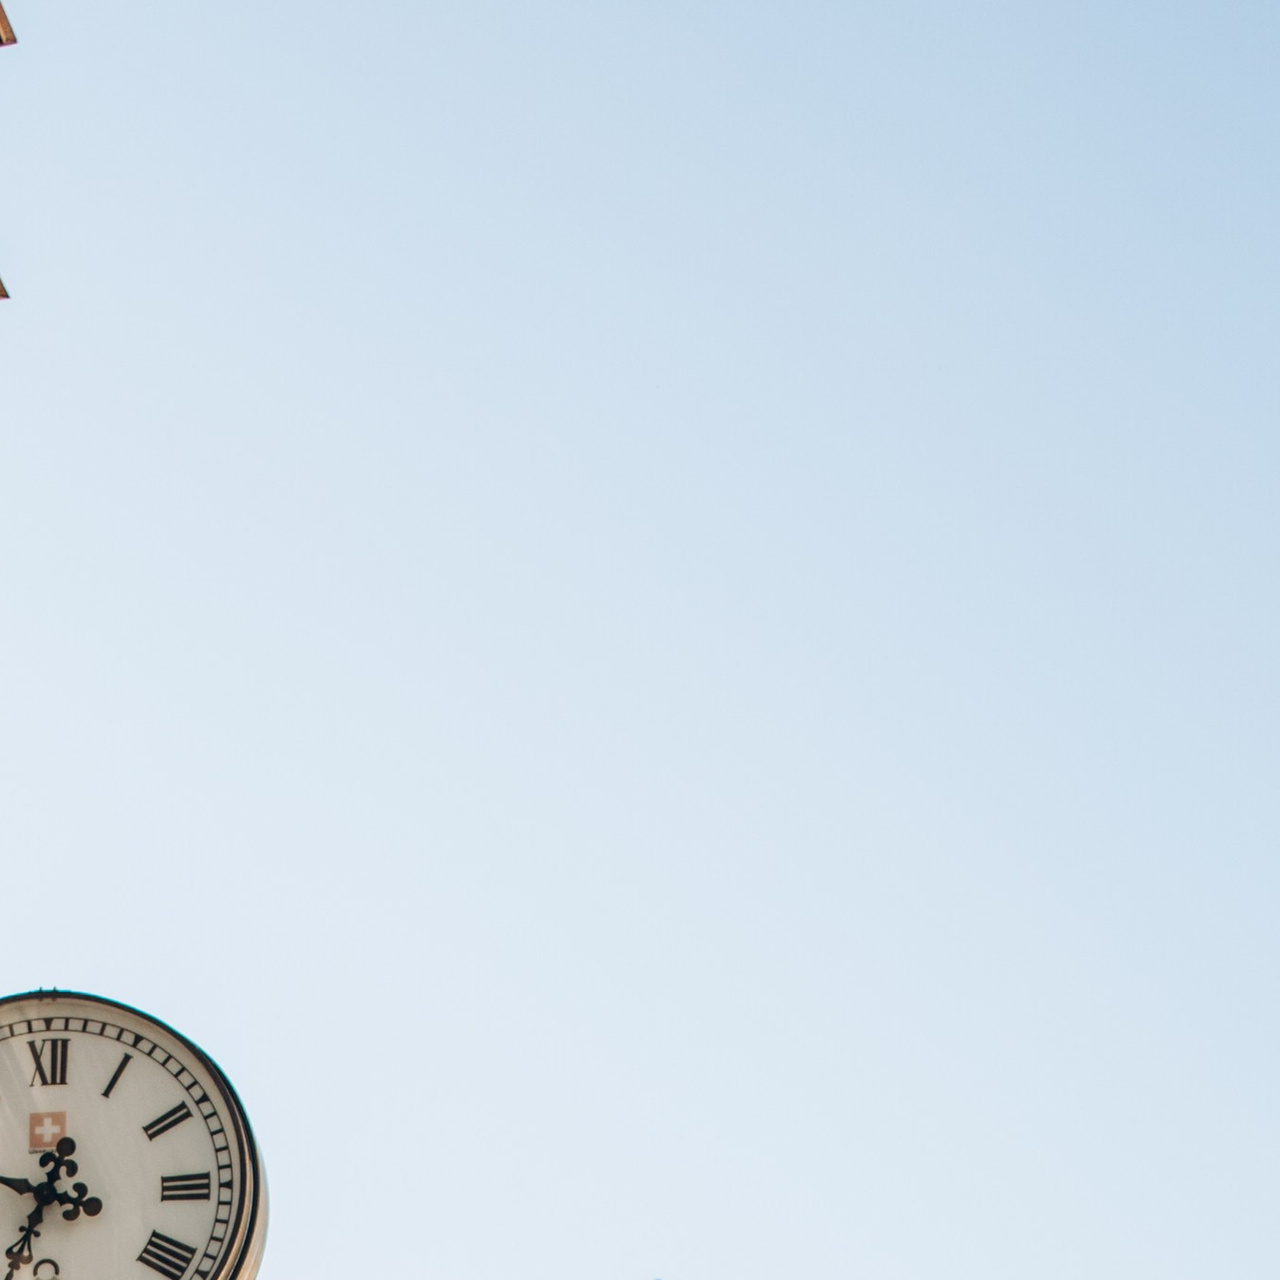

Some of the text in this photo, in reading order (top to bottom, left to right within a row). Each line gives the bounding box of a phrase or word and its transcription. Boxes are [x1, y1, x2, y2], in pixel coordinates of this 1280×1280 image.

[26, 1038, 70, 1087] XII
[142, 1101, 193, 1141] II
[160, 1171, 211, 1201] III
